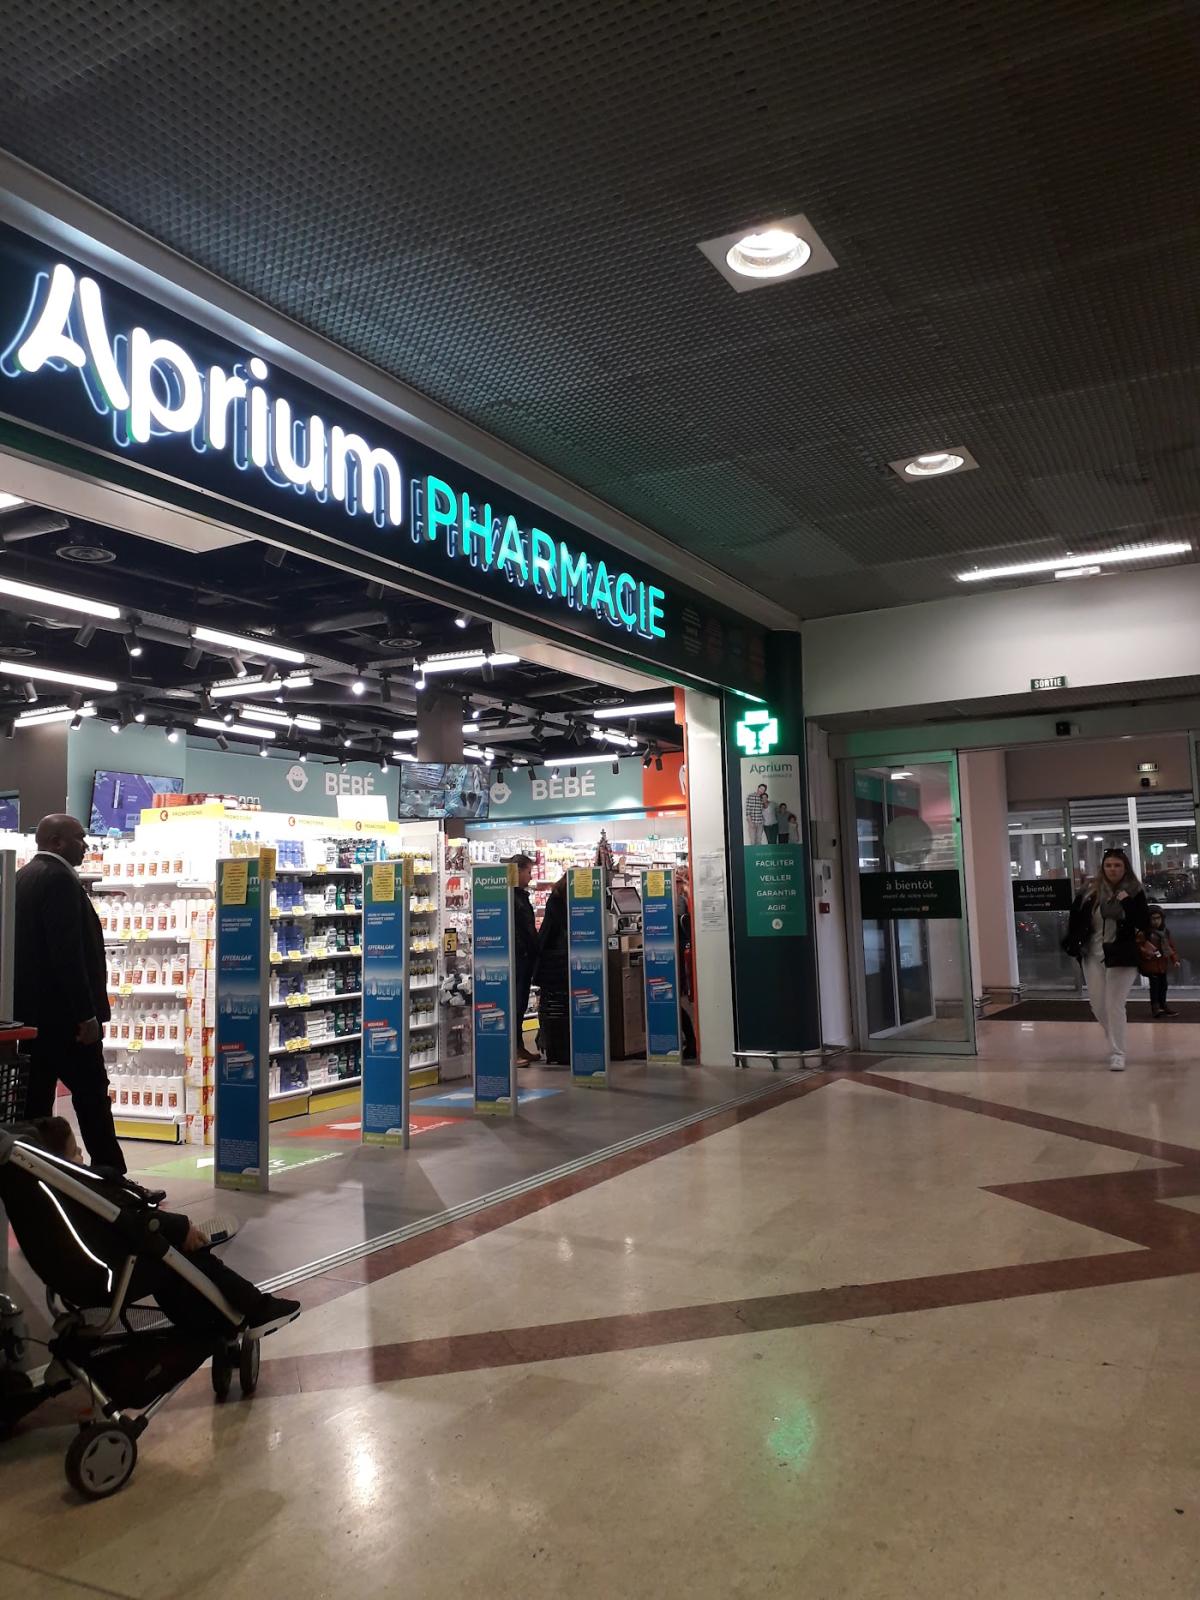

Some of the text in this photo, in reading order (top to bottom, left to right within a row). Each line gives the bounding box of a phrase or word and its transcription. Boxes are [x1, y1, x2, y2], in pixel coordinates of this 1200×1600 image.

[16, 263, 666, 638] Aprium PHARMACIE
[1034, 677, 1062, 689] SORTIE
[749, 762, 793, 775] Aprium
[755, 859, 795, 867] FACILITER
[474, 875, 508, 886] Aprium
[759, 874, 792, 882] VEILLER
[895, 879, 934, 890] bientôt
[756, 889, 797, 897] GARANTIR
